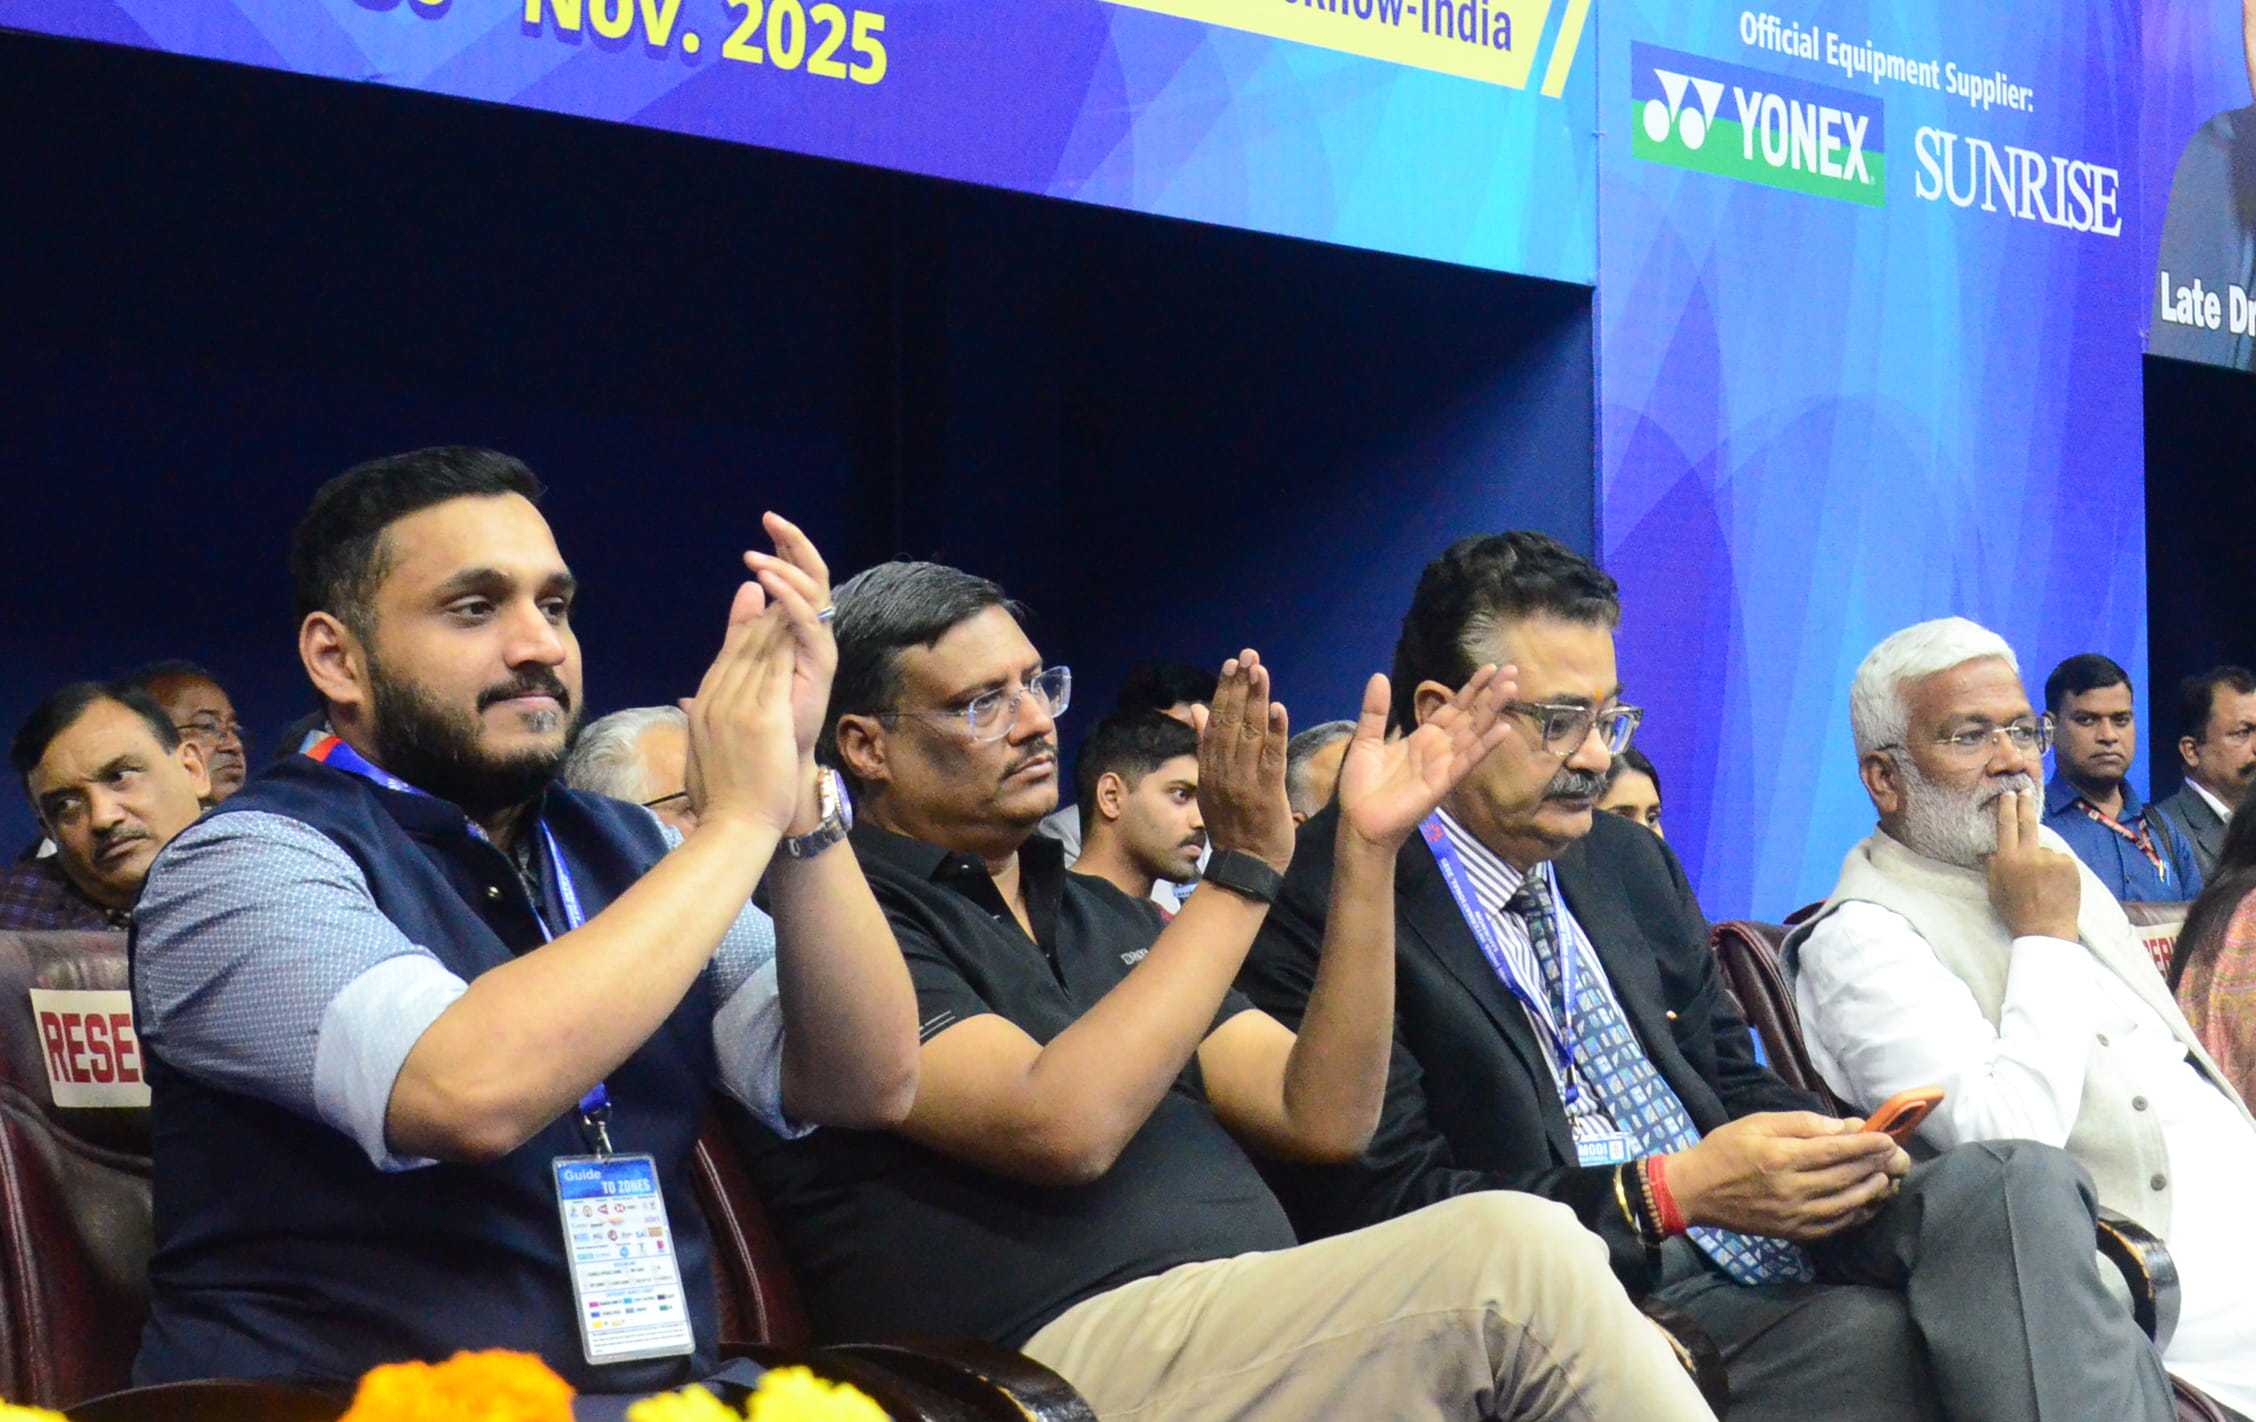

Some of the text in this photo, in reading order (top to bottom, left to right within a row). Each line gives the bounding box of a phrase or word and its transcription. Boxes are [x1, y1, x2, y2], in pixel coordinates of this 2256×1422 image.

[722, 0, 887, 85] 2025
[1740, 11, 2034, 112] Official Equipment Supplier:
[1733, 86, 1869, 184] YONEX
[1914, 125, 2123, 237] SUNRISE
[2160, 270, 2221, 331] Late
[40, 1011, 146, 1083] RESE
[564, 1169, 602, 1181] Guide
[602, 1178, 651, 1195] TO ZONES
